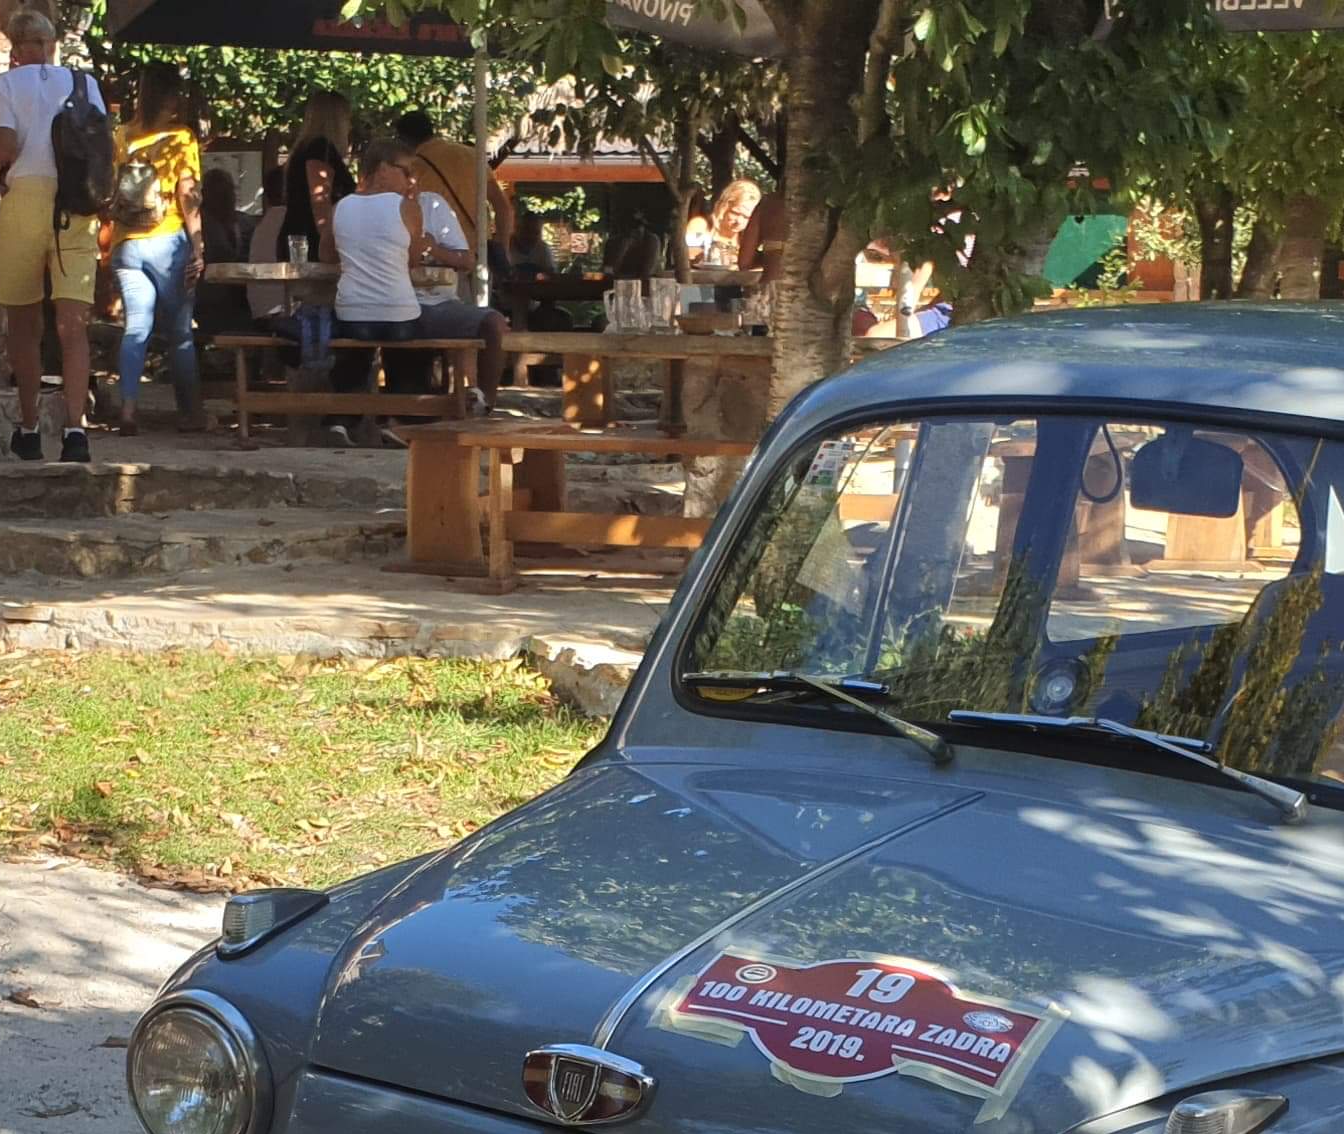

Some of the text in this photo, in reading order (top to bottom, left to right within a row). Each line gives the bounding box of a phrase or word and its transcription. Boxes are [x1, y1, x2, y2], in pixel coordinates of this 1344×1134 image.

[845, 968, 916, 1003] 19
[699, 981, 749, 1001] 100
[749, 988, 918, 1037] KILOMETARA
[918, 1024, 1011, 1063] ZADRA
[790, 1026, 865, 1062] 2019.
[561, 1070, 587, 1103] FIAT
